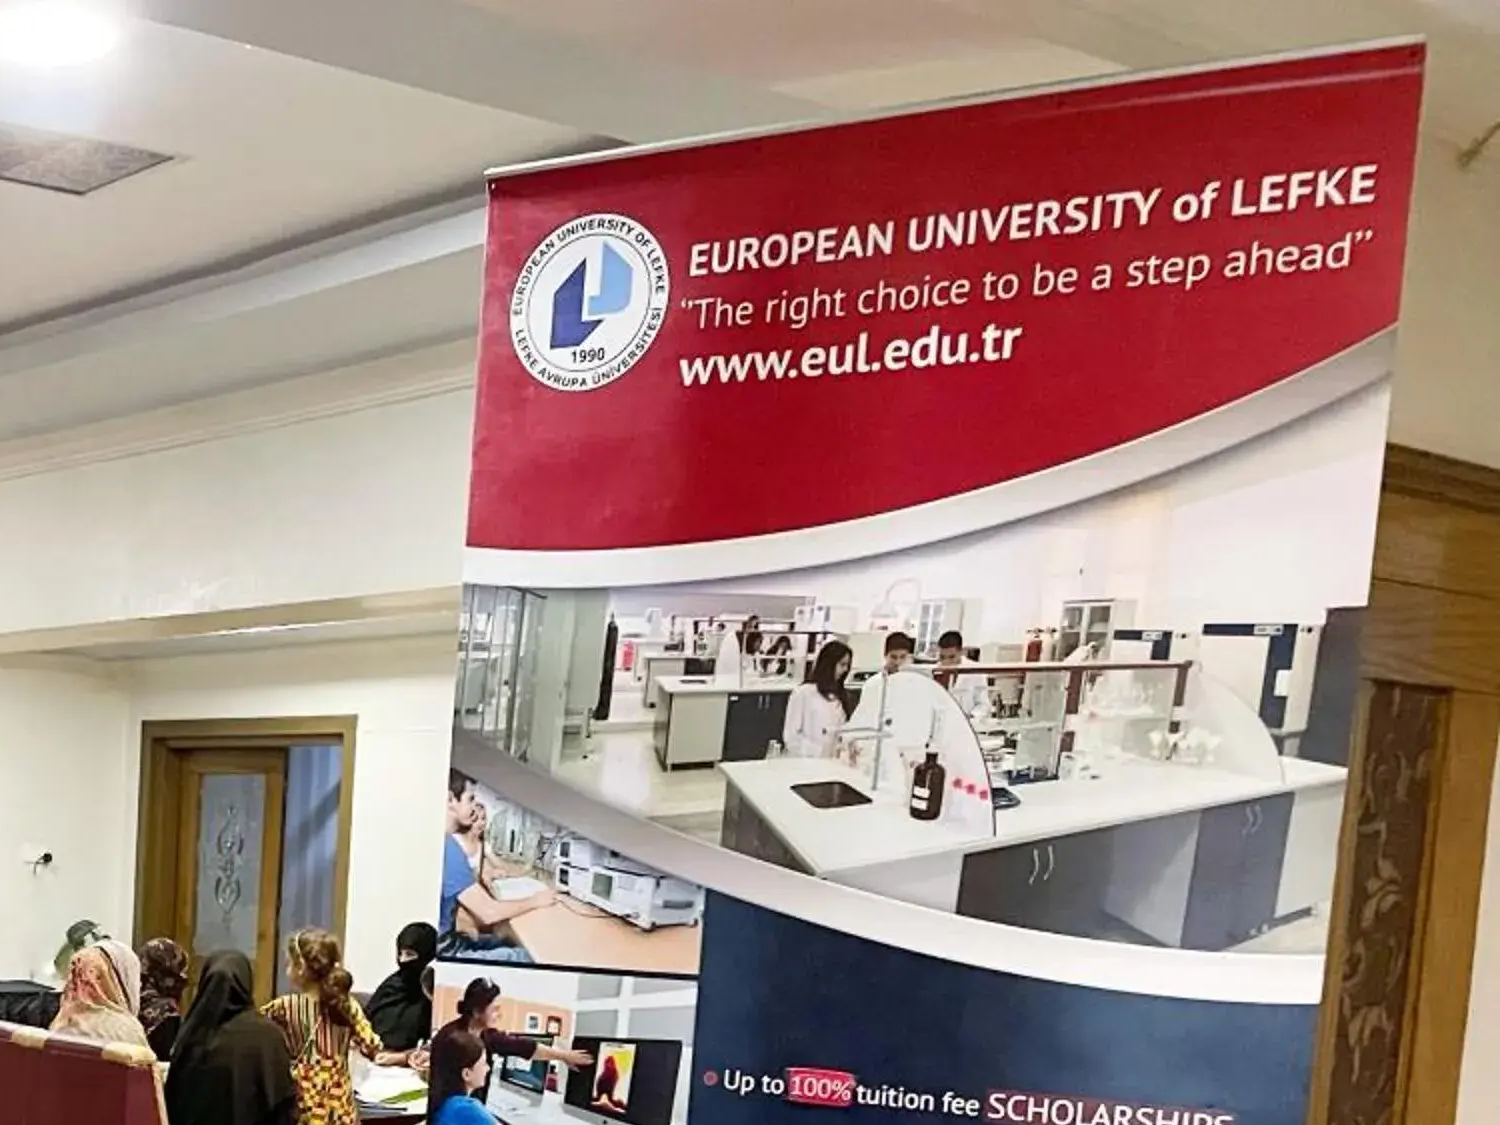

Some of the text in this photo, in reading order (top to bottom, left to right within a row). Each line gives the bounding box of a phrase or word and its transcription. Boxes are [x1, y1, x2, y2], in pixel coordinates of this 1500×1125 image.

[688, 163, 1379, 277] EUROPEAN UNIVERSITY of LEFKE
[513, 217, 666, 315] EUROPEAN UNIVERSITY OF LEFKE
[765, 286, 847, 329] right
[857, 274, 971, 315] choice
[982, 270, 1019, 302] to
[1032, 262, 1079, 297] be
[1091, 263, 1112, 290] a
[1125, 253, 1211, 291] step
[516, 329, 538, 371] LEFKE
[537, 369, 589, 388] AVRUPA
[571, 347, 606, 364] 1990
[678, 322, 1023, 387] www.eul.edu.tr
[722, 1068, 755, 1095] Up
[762, 1075, 785, 1095] to
[790, 1075, 852, 1102] 100%
[856, 1084, 935, 1112] tuition
[942, 1091, 980, 1117] fee
